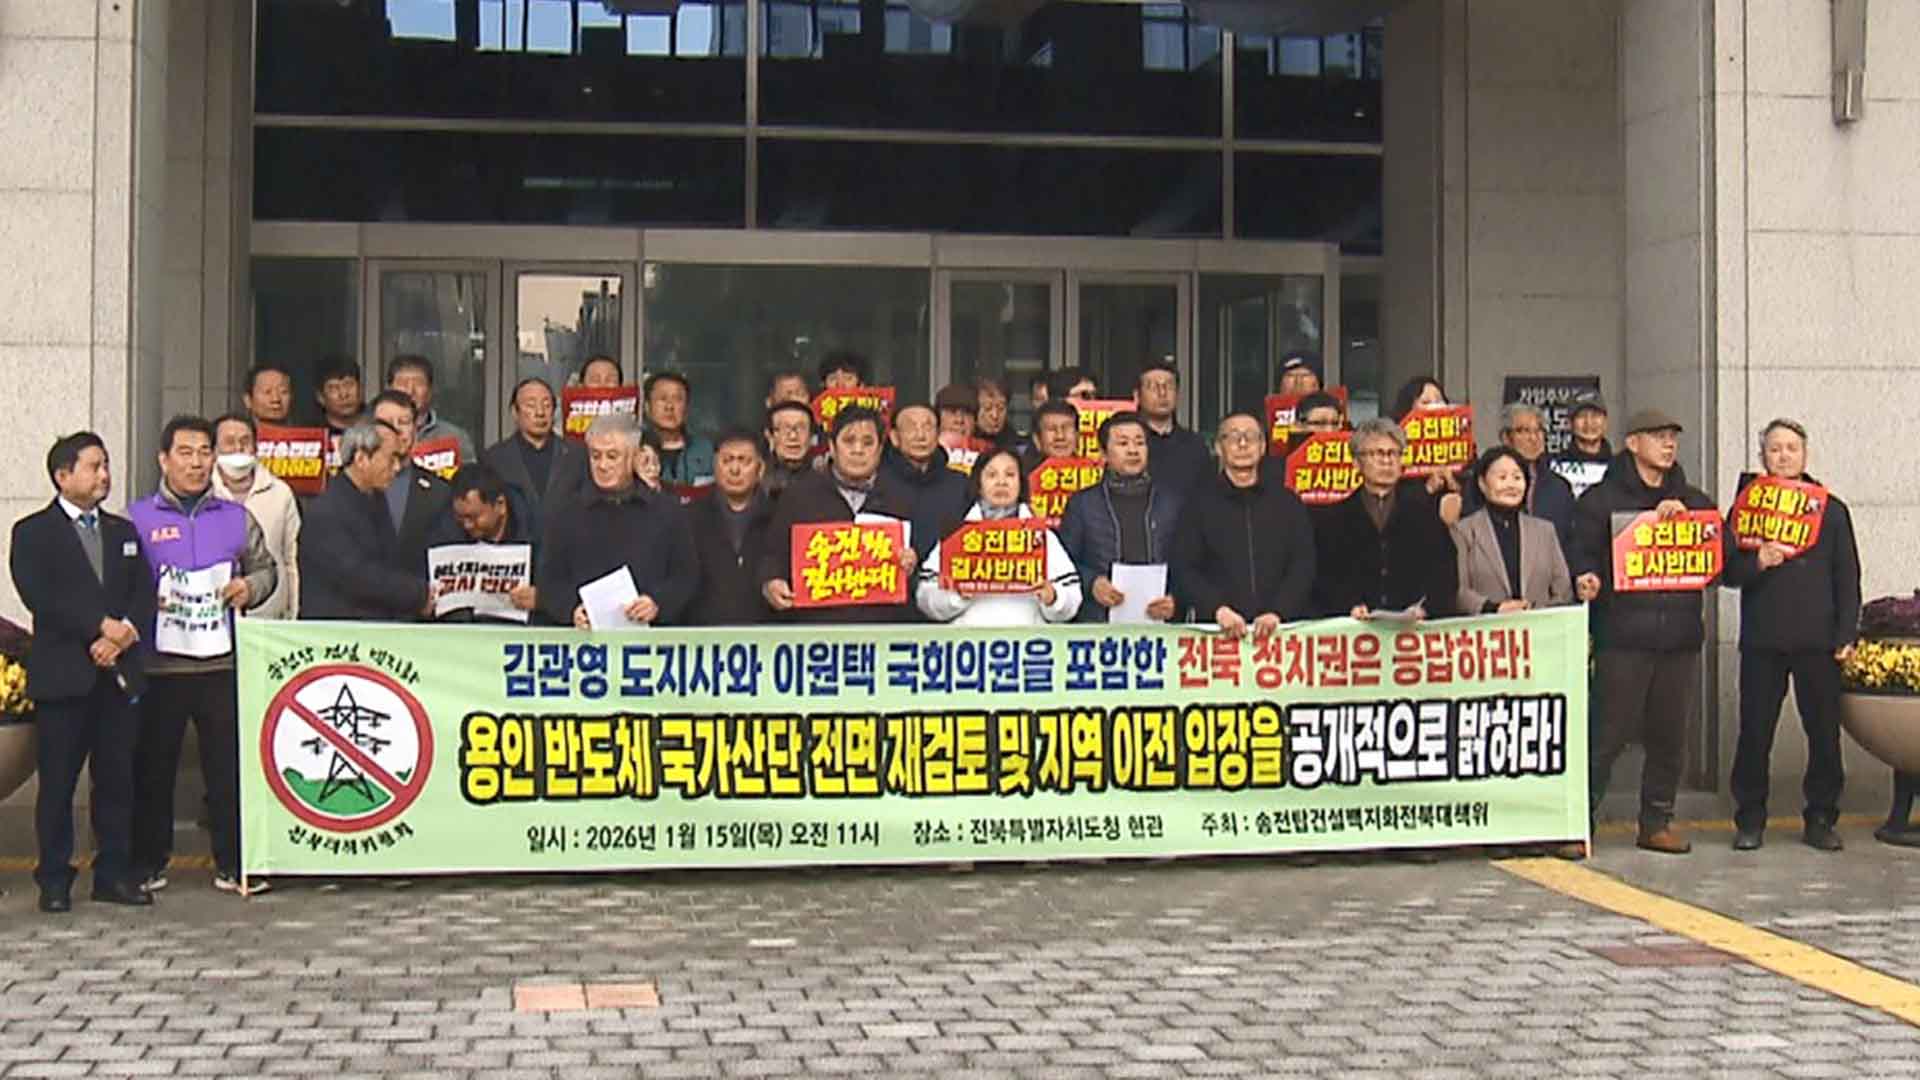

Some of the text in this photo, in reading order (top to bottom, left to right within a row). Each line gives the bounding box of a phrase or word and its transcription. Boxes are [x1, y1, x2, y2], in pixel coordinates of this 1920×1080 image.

[1406, 417, 1461, 440] 송전탑!
[1749, 485, 1807, 513] 송전탑!
[962, 529, 1034, 554] 송전탑!
[1633, 520, 1703, 546] 송전탑!
[1736, 511, 1810, 546] 결사반대!
[951, 558, 1043, 583] 결사반대!
[1625, 551, 1713, 577] 결사반대!
[802, 562, 896, 601] 결사반대
[503, 629, 1531, 698] 김관영 도지사와 이원택 국회의원을 포함한 전북 정치권은 응답하라!
[464, 698, 1563, 799] 용인 반도체 국가산단 전면 재검토 및 지역 이전 입장을 공개적으로 밝혀라!
[913, 820, 951, 846] 장소
[970, 816, 1121, 845] 전북특별자치도청
[1127, 815, 1164, 840] 현관
[1201, 811, 1238, 837] 주최
[1255, 803, 1489, 835] 송전탑건설백지화전북대책위
[527, 826, 566, 852] 일시
[586, 826, 656, 851] 2026년
[666, 822, 696, 849] 1월
[706, 822, 782, 849] 15일(목)
[789, 822, 829, 847] 오전
[837, 821, 879, 847] 11시
